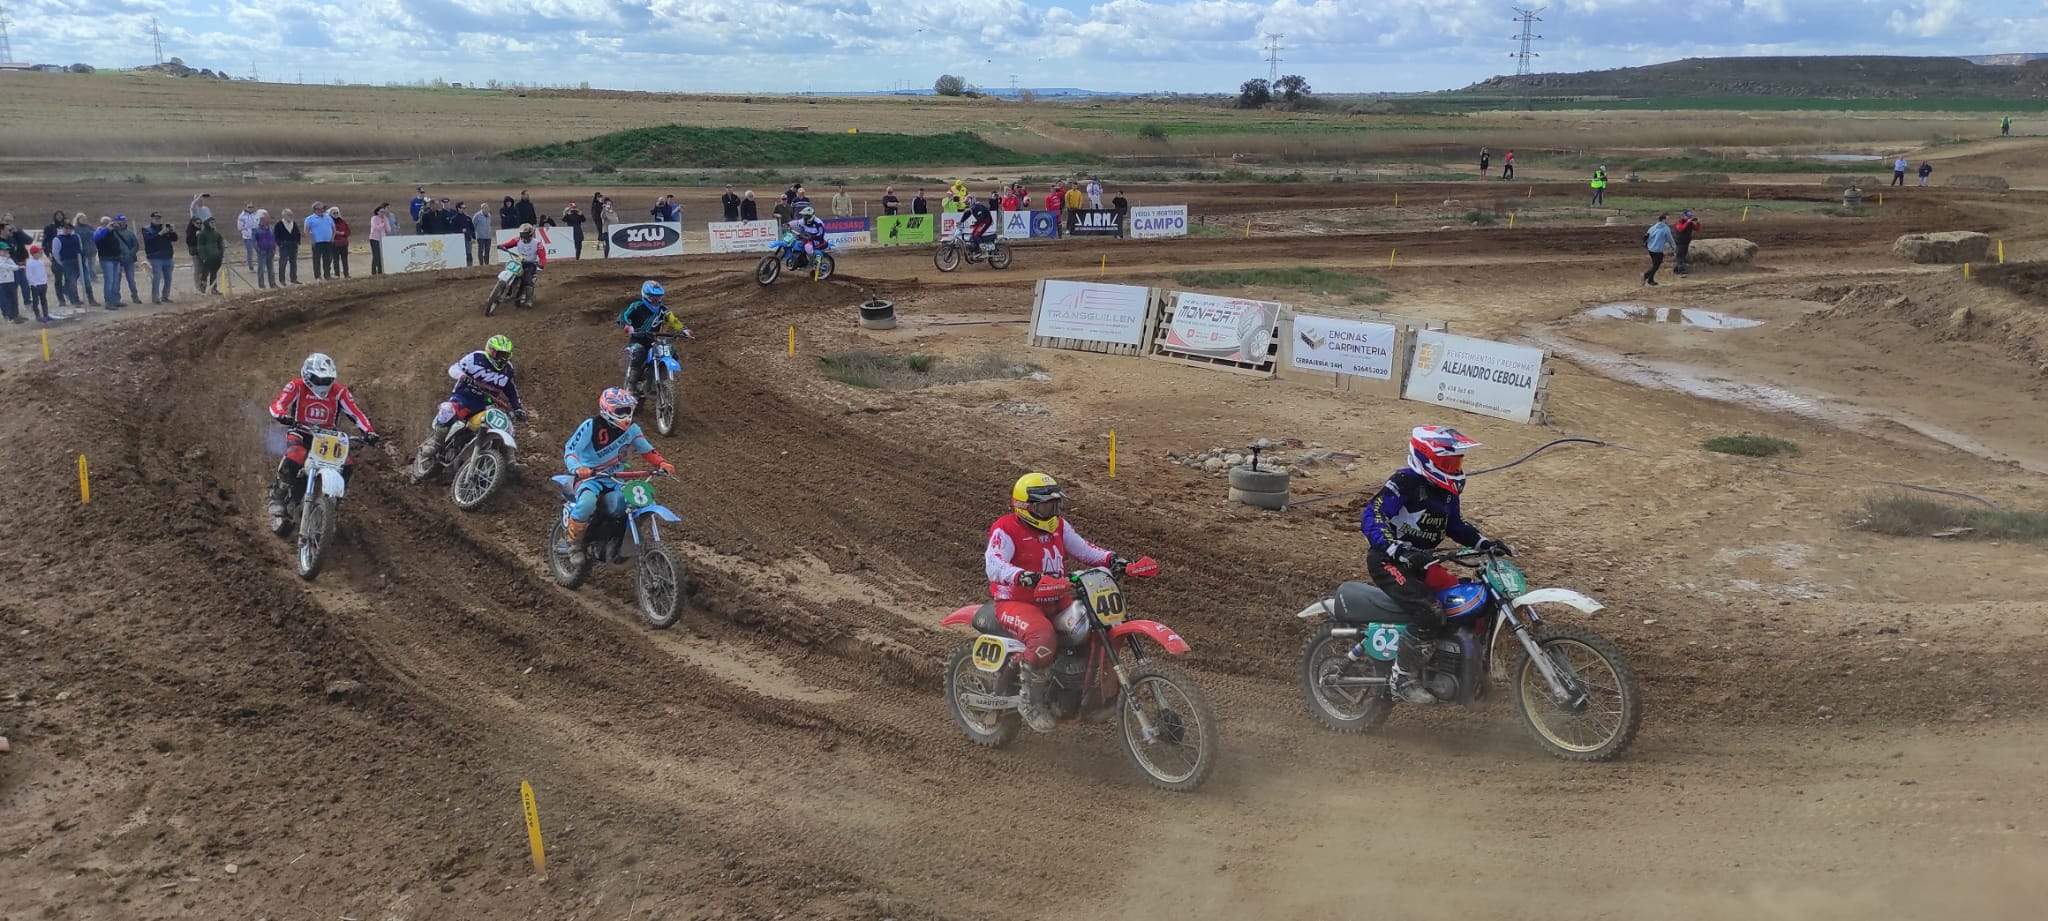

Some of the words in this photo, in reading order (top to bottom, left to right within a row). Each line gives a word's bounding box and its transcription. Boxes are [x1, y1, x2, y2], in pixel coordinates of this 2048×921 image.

[1084, 213, 1111, 227] ARM
[1134, 217, 1184, 231] CAMPO
[1329, 330, 1368, 343] ENCINAS
[1328, 342, 1387, 357] CARPINTERIA
[1441, 360, 1491, 380] ALEJANDRO
[1492, 370, 1532, 389] CEBOLLA
[491, 415, 504, 428] 10
[319, 441, 342, 459] 56
[632, 485, 649, 505] 8
[1096, 592, 1124, 616] 40
[1373, 628, 1400, 652] 62
[976, 642, 1002, 664] 40
